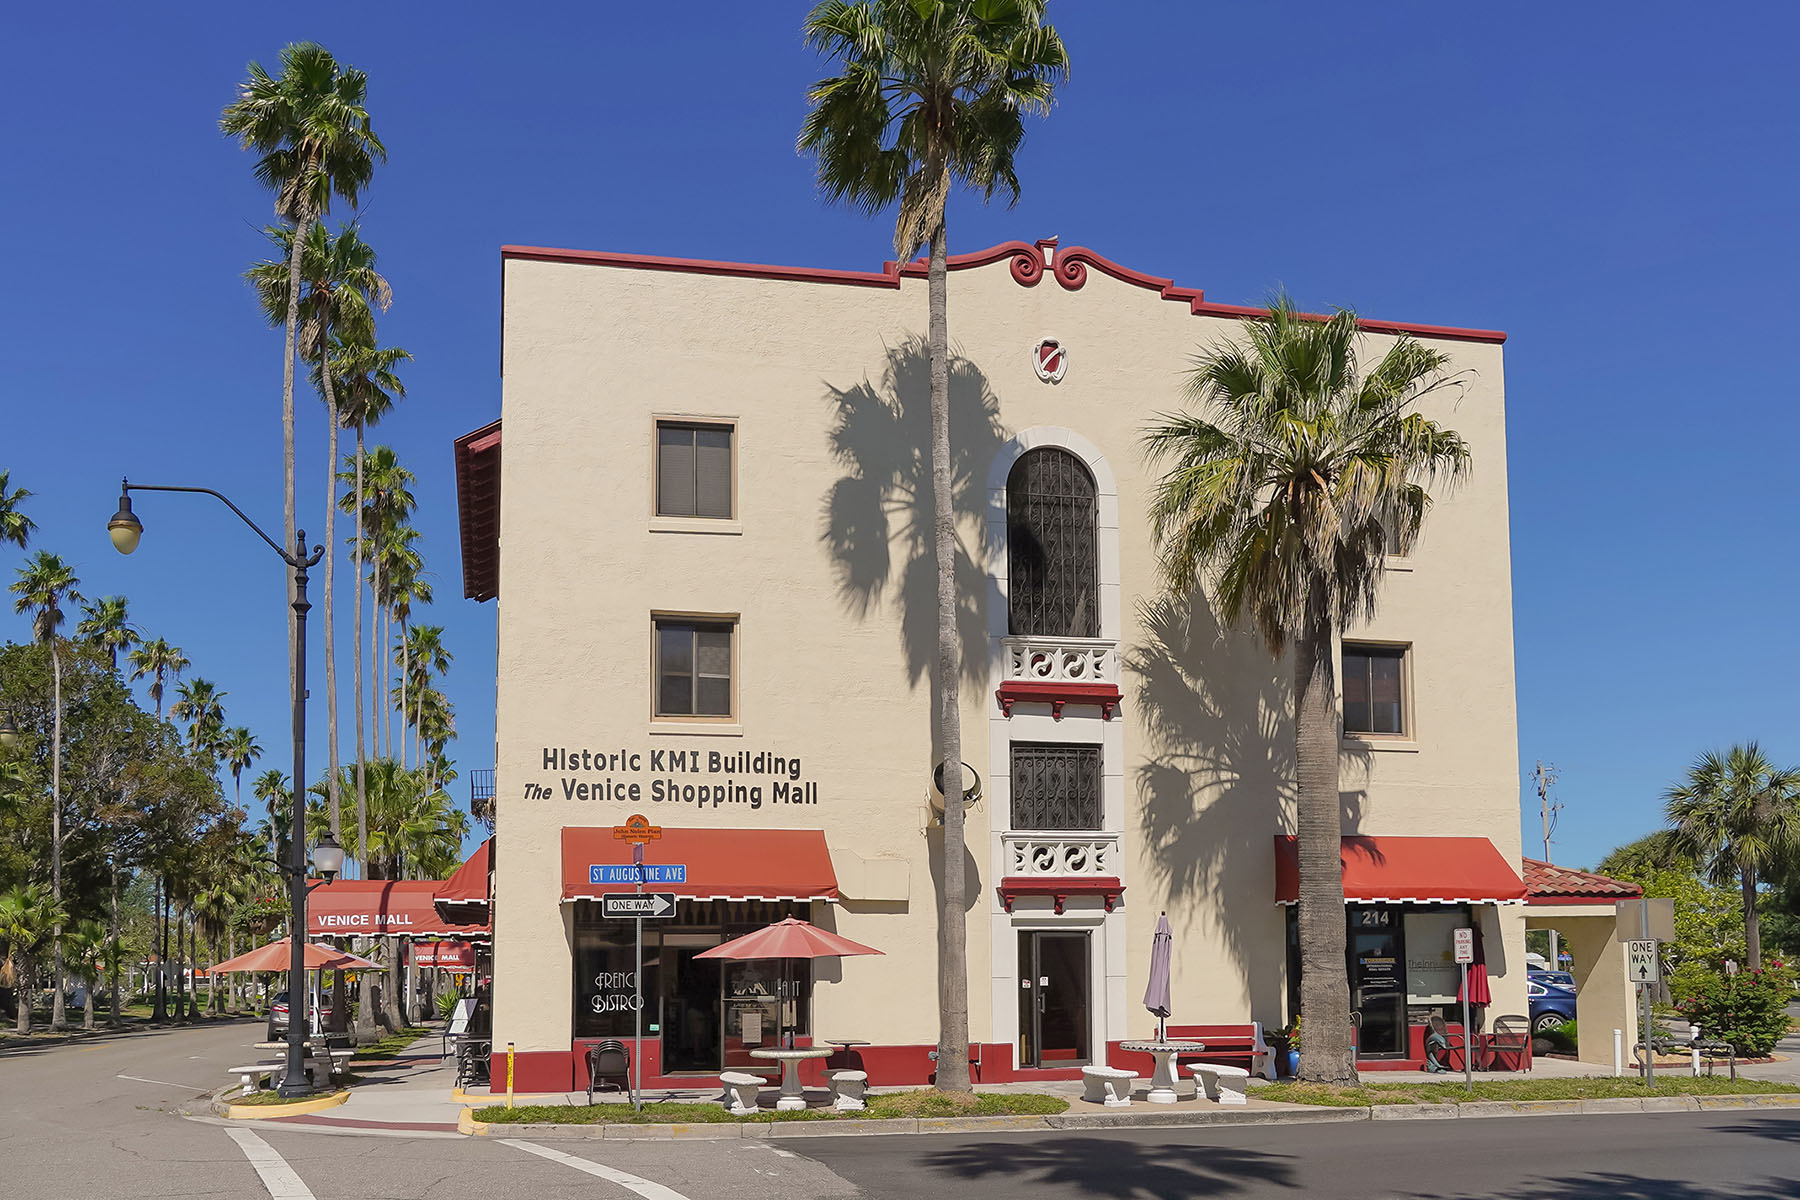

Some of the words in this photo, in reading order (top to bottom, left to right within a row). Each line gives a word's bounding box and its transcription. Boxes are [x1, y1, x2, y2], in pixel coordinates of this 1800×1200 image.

[650, 749, 700, 773] KMI
[708, 751, 801, 781] Building
[524, 783, 553, 800] The
[561, 777, 641, 802] Venice
[651, 778, 762, 810] Shopping
[772, 781, 818, 805] Mall
[593, 867, 604, 881] ST
[609, 867, 660, 881] AUGUSTINE
[665, 867, 683, 880] AVE
[611, 900, 632, 910] ONE
[634, 900, 655, 910] WAY
[318, 914, 369, 926] VENICE
[375, 914, 413, 925] MALL
[1362, 911, 1389, 925] 214
[1458, 931, 1468, 939] NO
[1631, 942, 1653, 952] ONE
[1631, 954, 1654, 964] WAY
[594, 972, 637, 990] FRENC
[591, 994, 645, 1014] BISTRO
